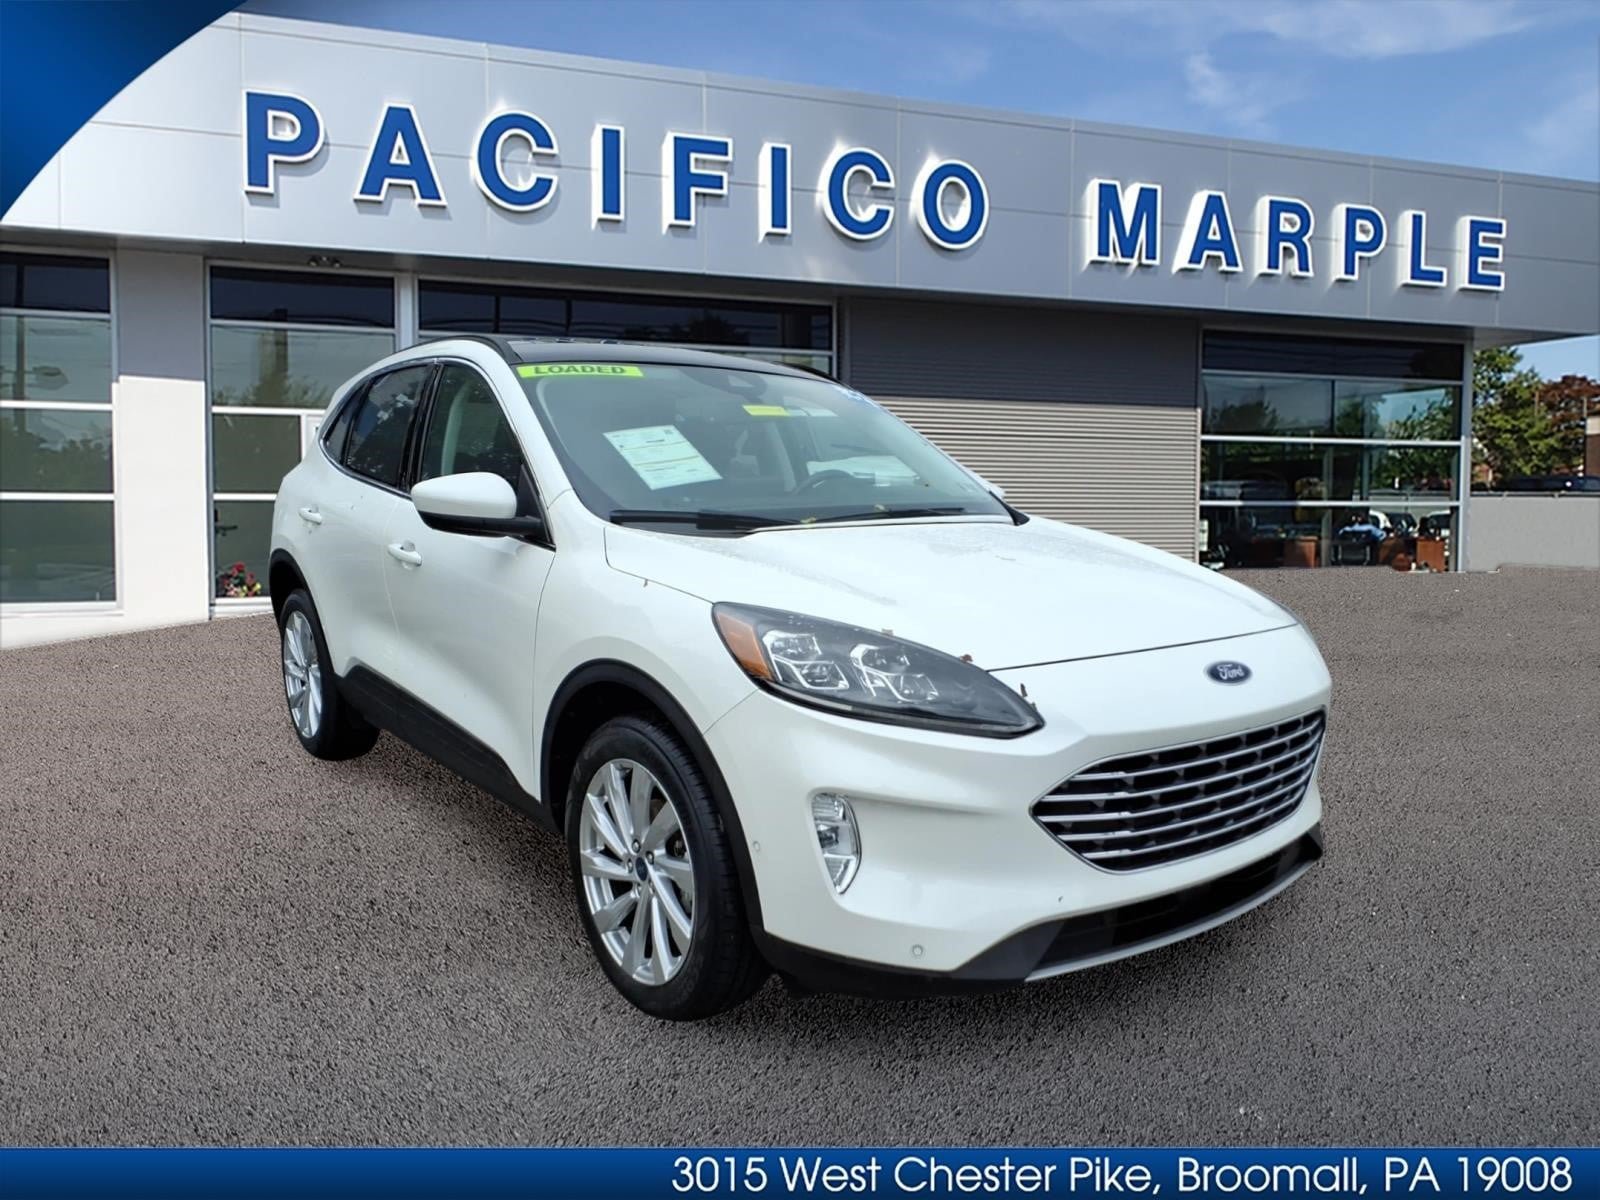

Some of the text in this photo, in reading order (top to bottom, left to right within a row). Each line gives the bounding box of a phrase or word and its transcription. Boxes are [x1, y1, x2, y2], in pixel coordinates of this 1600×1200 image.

[243, 89, 1508, 292] PACIFICO MARPLE
[534, 364, 626, 375] LOADED
[1213, 662, 1247, 681] Ford
